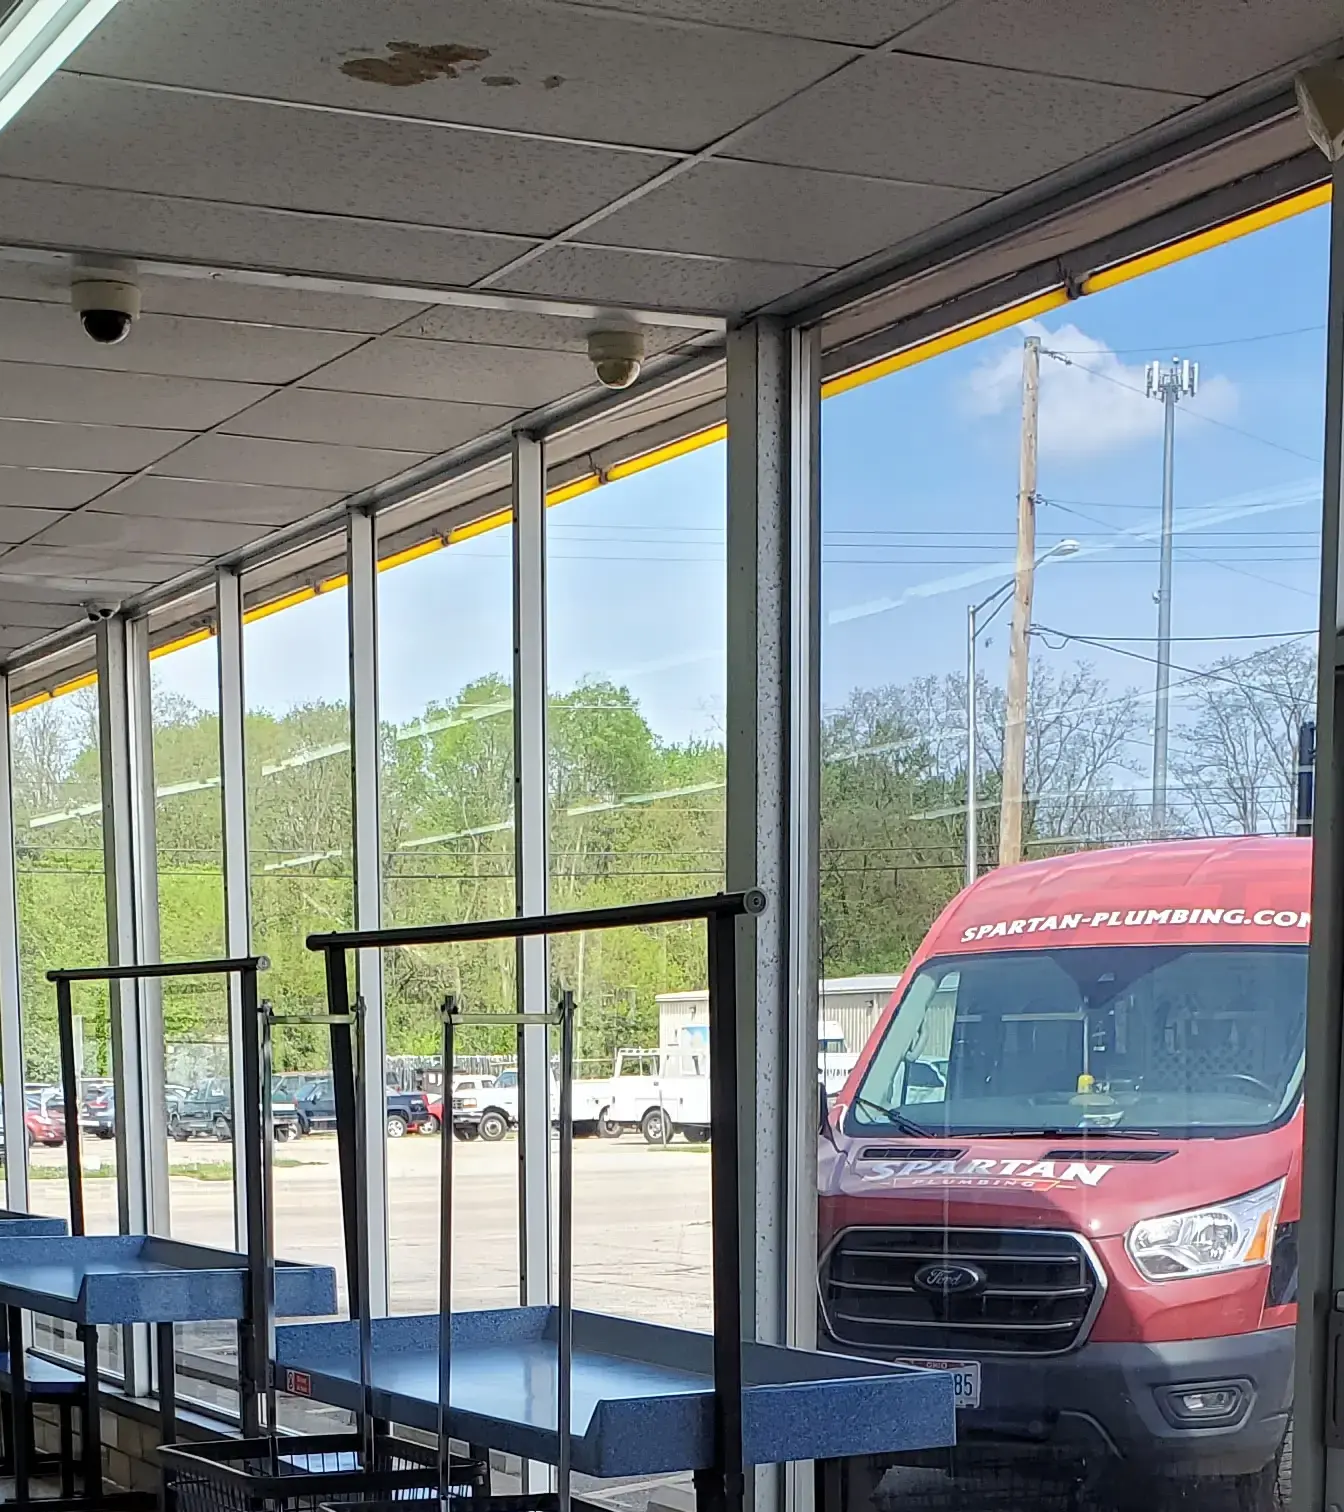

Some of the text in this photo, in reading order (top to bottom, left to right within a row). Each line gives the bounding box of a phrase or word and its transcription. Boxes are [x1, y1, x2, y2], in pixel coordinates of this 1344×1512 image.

[860, 1158, 1115, 1187] SPARTAN
[911, 1178, 1036, 1188] PLUMBING
[926, 1268, 963, 1287] Ford
